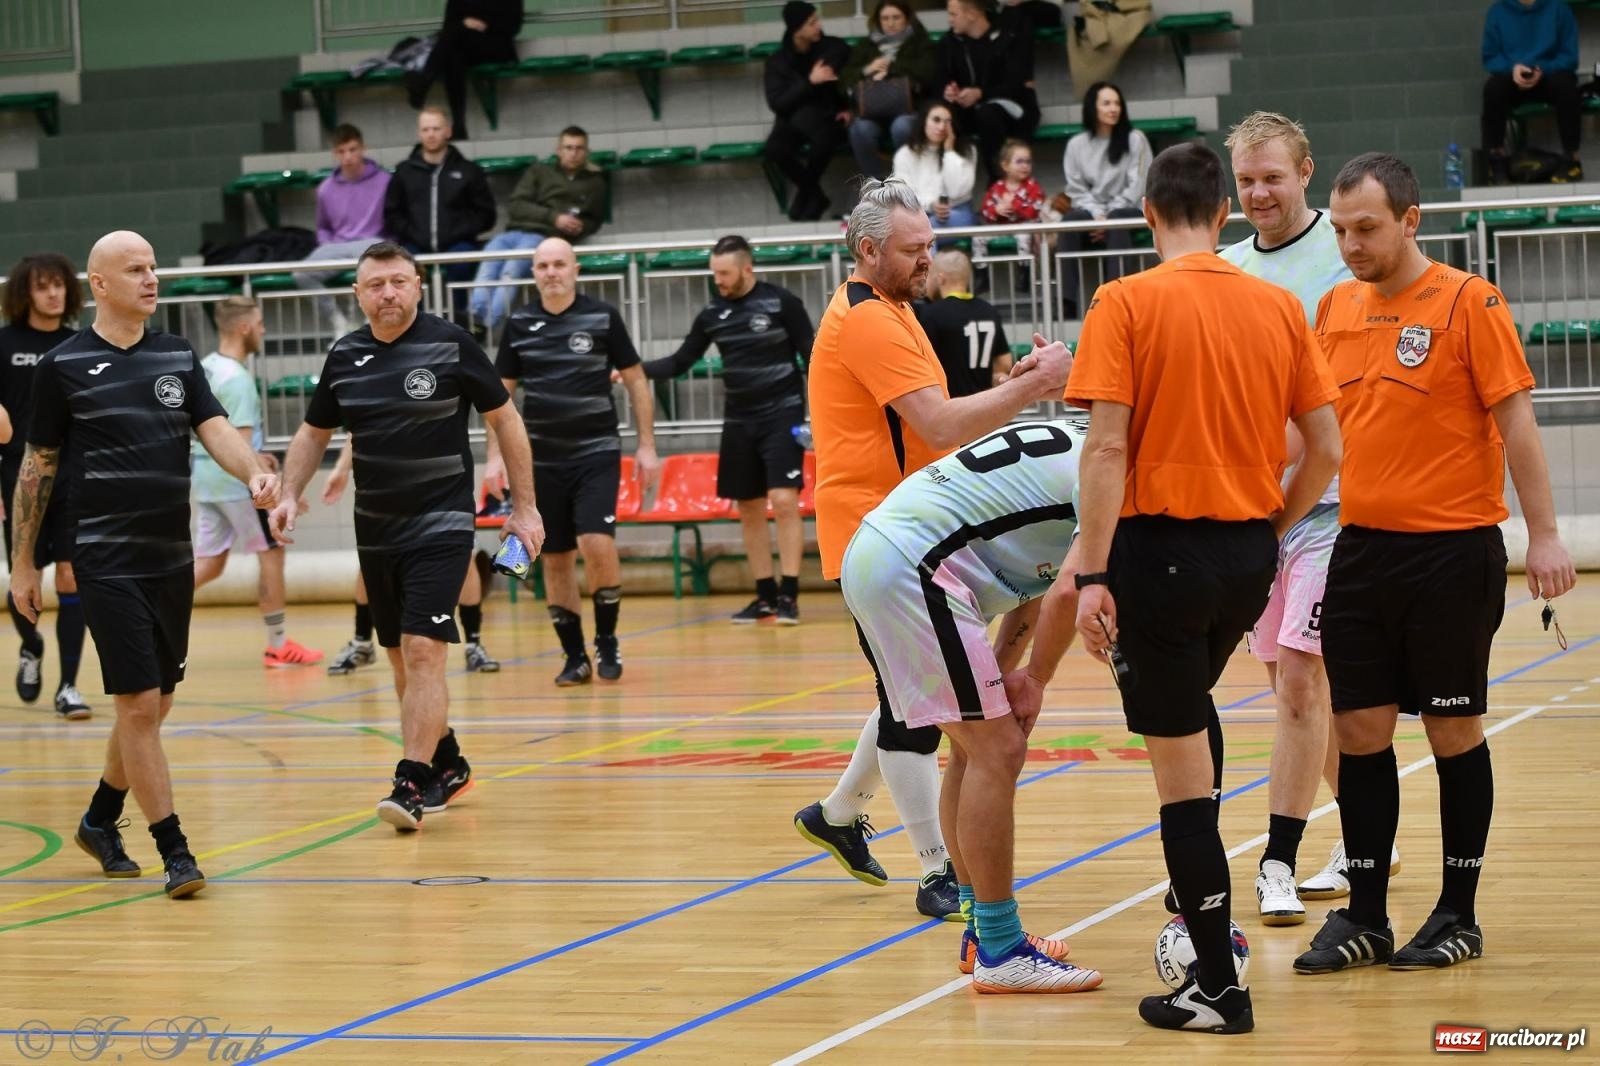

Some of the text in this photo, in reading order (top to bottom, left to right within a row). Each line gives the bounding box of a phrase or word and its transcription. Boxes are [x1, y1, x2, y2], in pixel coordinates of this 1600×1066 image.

[963, 320, 996, 369] 17
[1405, 329, 1427, 337] FUTSAL
[955, 424, 1072, 473] 8
[1431, 696, 1470, 707] zina
[1158, 934, 1180, 982] SELECT
